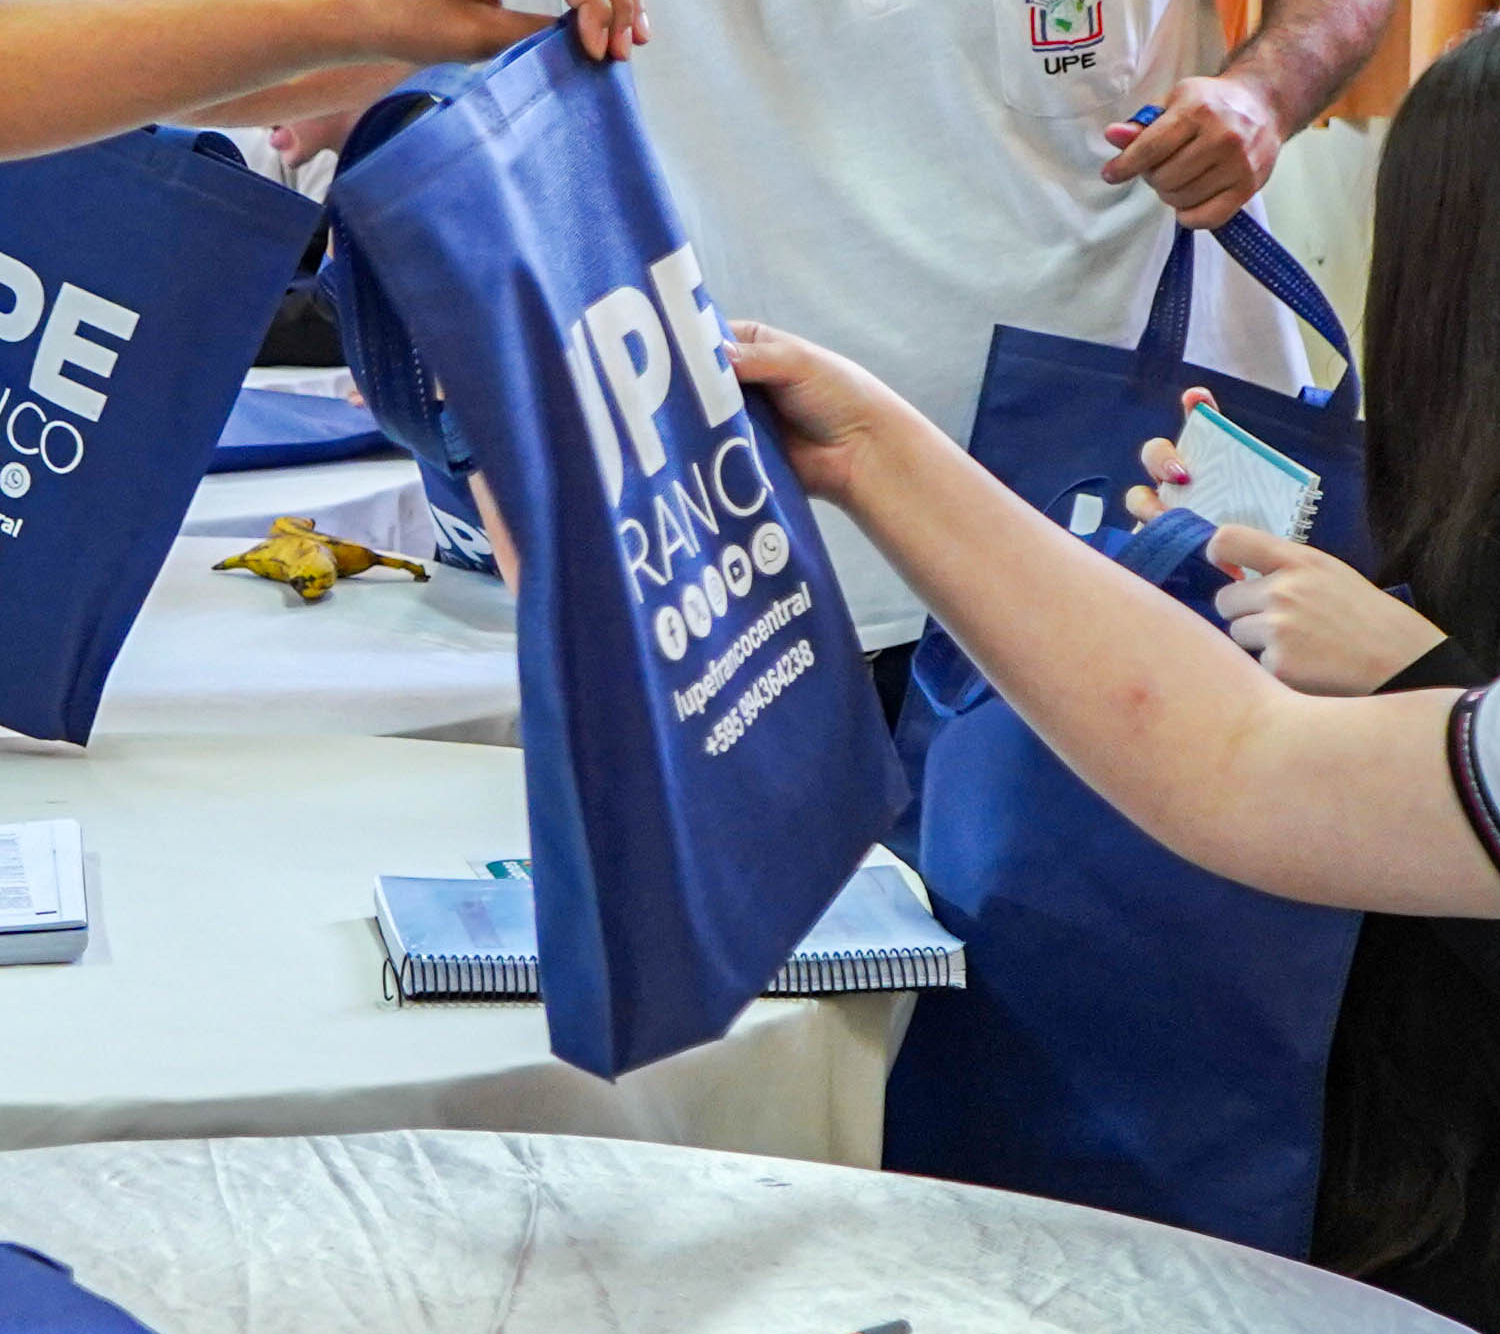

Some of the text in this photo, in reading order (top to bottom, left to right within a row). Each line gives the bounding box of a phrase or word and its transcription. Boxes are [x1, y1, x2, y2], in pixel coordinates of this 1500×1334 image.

[1044, 52, 1096, 75] UPE
[618, 422, 774, 604] RANC
[705, 639, 815, 756] +595 994364238
